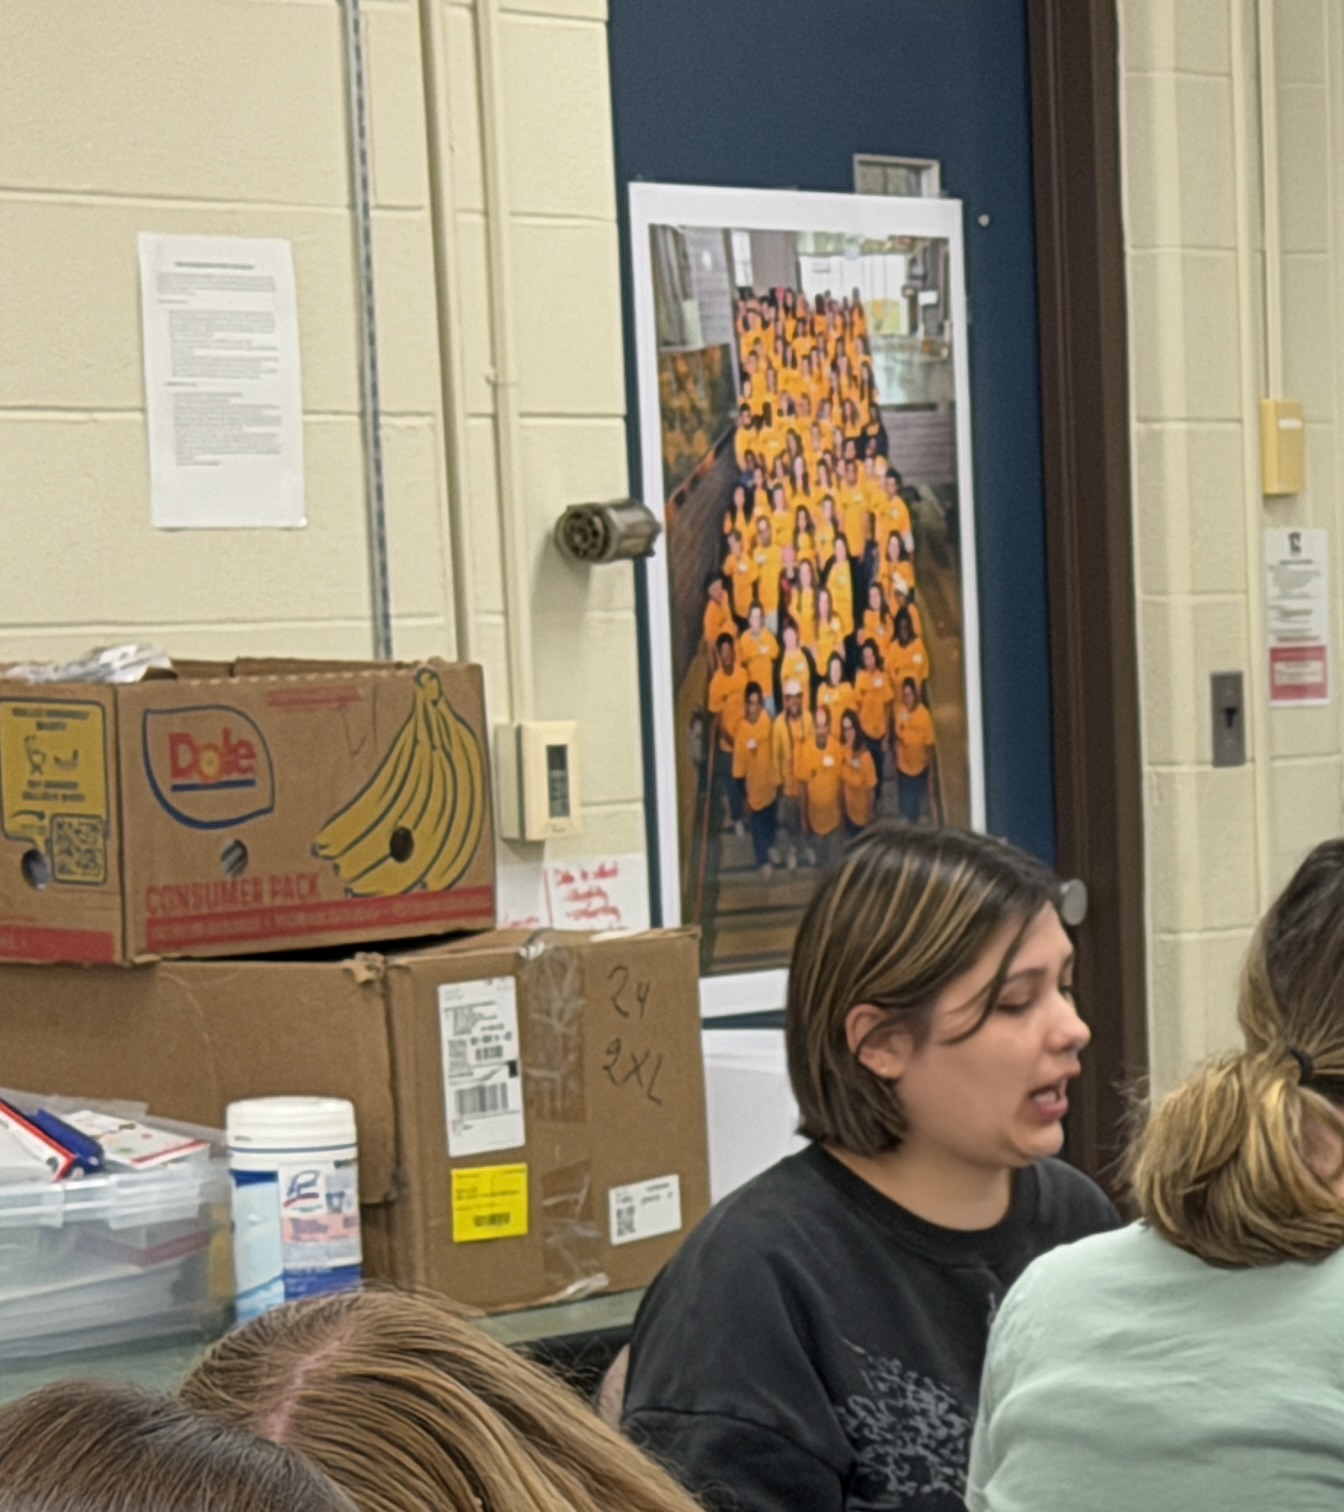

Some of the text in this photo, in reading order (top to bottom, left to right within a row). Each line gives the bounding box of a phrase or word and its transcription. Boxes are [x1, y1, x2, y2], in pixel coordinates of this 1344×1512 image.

[168, 728, 257, 780] Dole
[145, 872, 321, 917] CONSUMER PACK
[602, 1037, 663, 1107] 2XL
